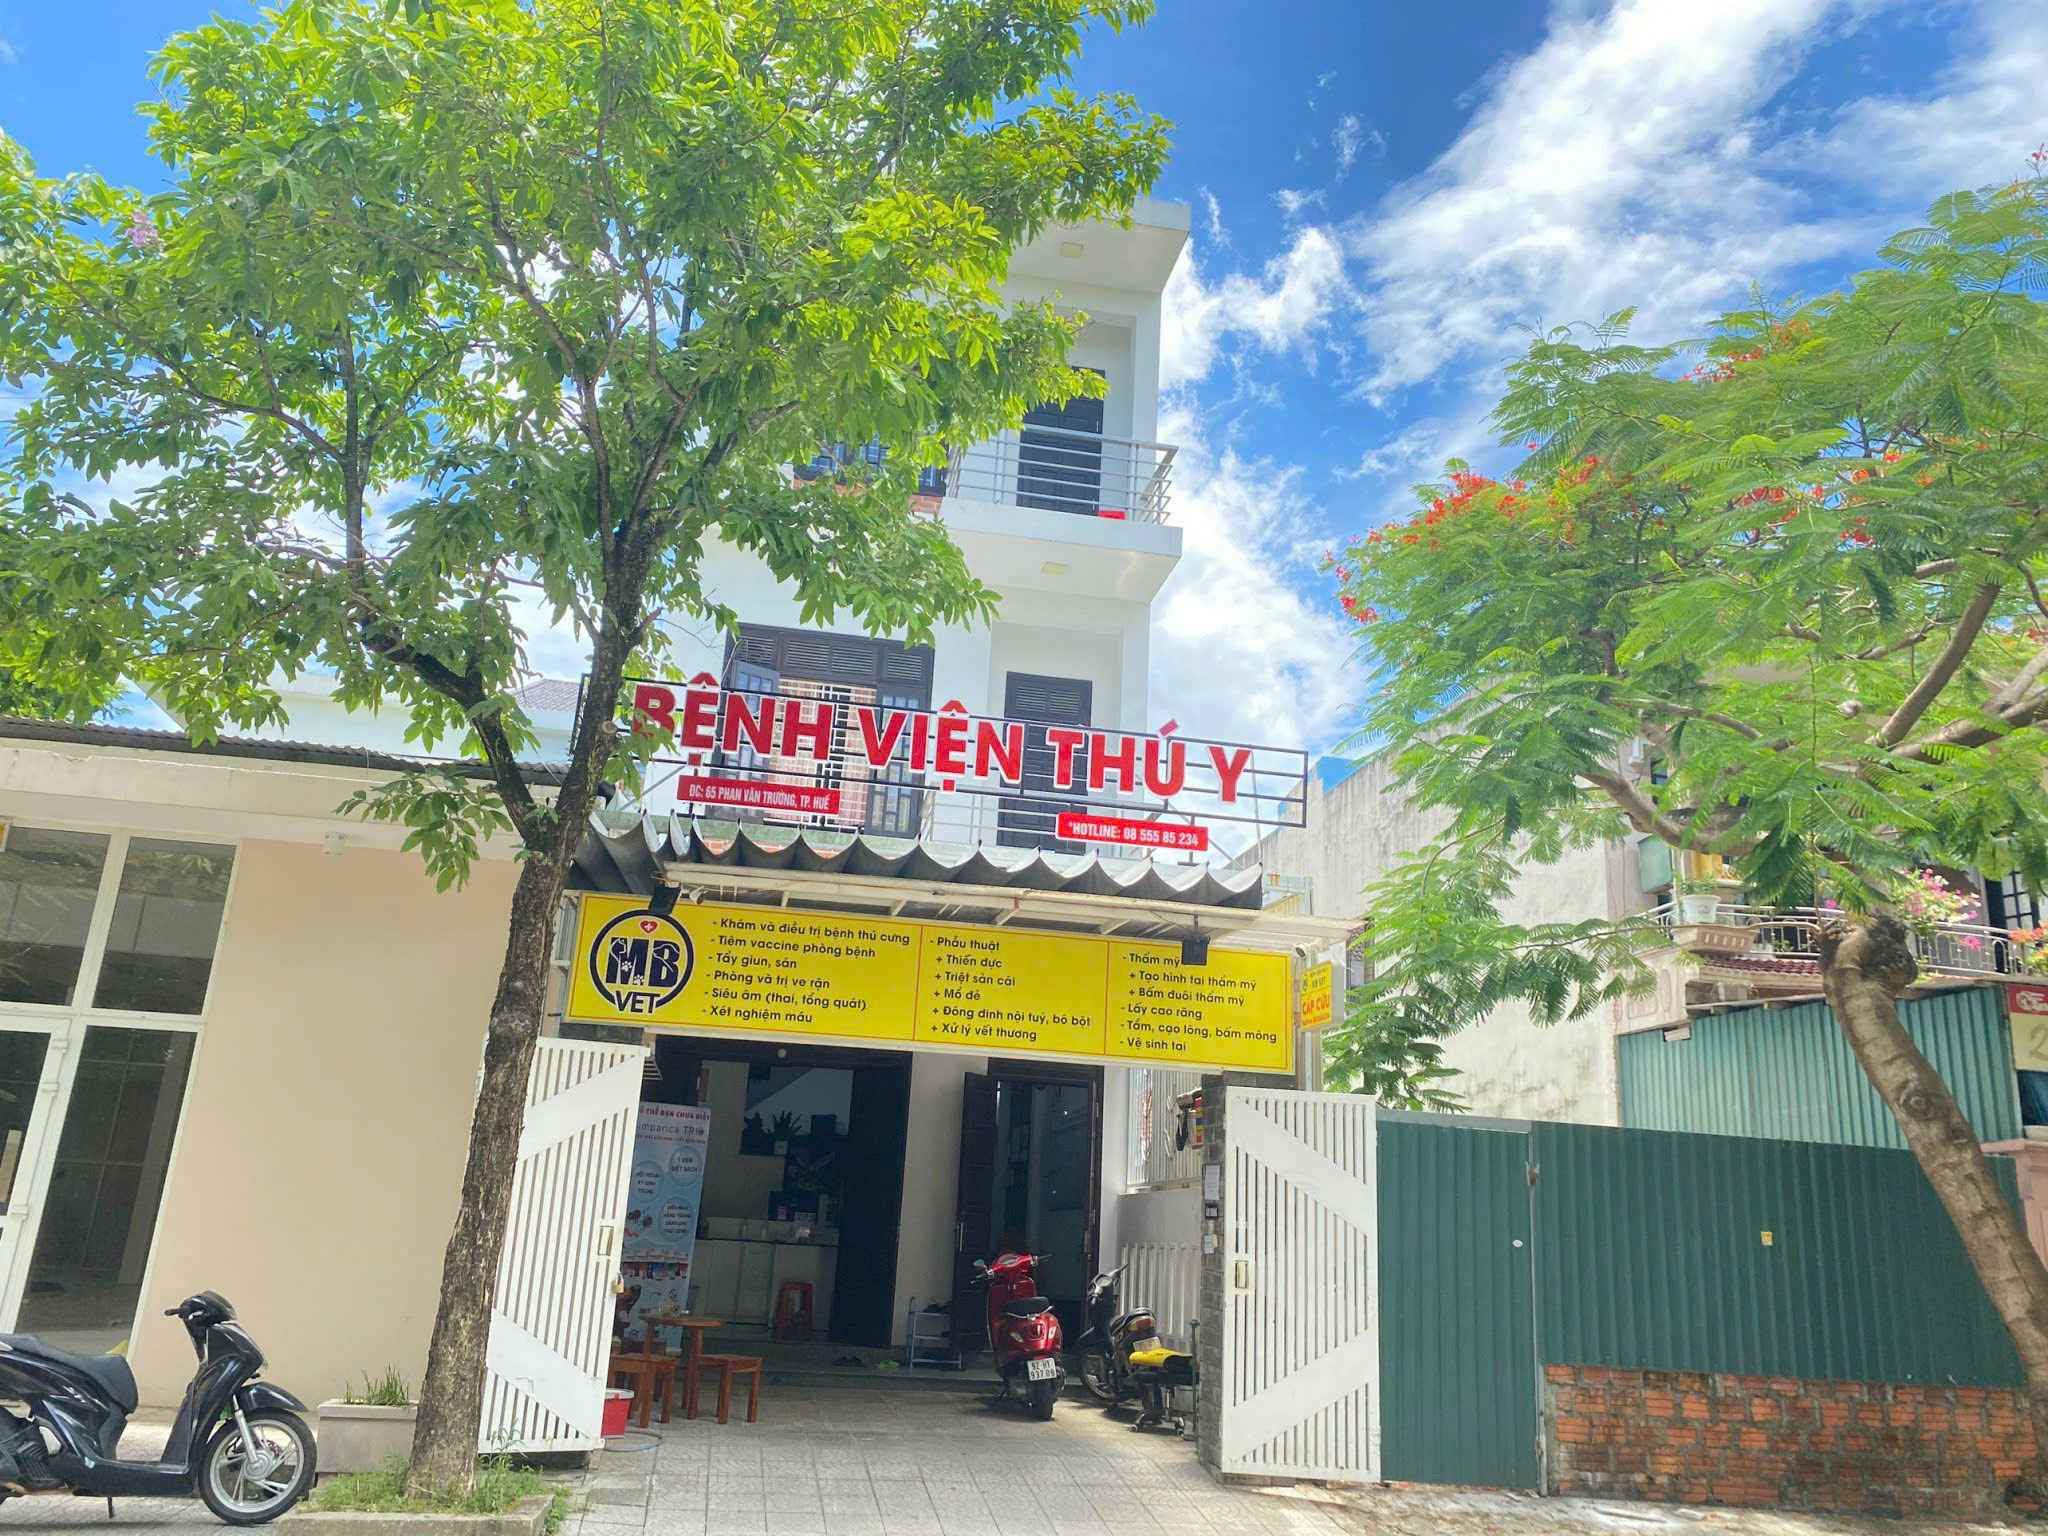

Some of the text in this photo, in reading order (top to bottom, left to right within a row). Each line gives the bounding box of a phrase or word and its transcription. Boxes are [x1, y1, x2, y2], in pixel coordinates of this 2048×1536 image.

[633, 672, 1252, 803] BỆNH VIỆN THÚ Y
[705, 786, 716, 799] 65
[718, 786, 741, 800] PHAN
[744, 787, 760, 802] VĂN
[800, 795, 811, 807] TP.
[813, 794, 830, 810] HUẾ
[1124, 827, 1137, 839] 08
[1140, 830, 1159, 842] 555
[1162, 832, 1175, 844] 85
[1179, 833, 1198, 846] 234
[720, 918, 910, 946] Khám và điều trị bệnh thú cưng
[718, 935, 876, 959] Tiêm vaccine phòng bệnh
[937, 936, 999, 953] Phẫu thuật
[606, 937, 680, 988] MB
[716, 951, 797, 969] Tẩy giun, sán
[946, 954, 976, 966] Thiến
[1129, 951, 1181, 968] Thẩm mỹ
[714, 970, 830, 991] Phòng và trị ve rận
[945, 971, 969, 984] Triệt
[997, 975, 1015, 986] cái
[1138, 970, 1256, 991] Tạo hình tai thẩm mỹ
[615, 990, 660, 1014] VET
[712, 987, 866, 1012] Siêu âm (thai, tổng quát)
[944, 986, 981, 1000] Mổ đẻ
[1139, 986, 1245, 1007] Bấm đuôi thẩm mỹ
[710, 1005, 812, 1023] Xét nghiệm máu
[943, 1005, 974, 1019] Đóng
[1007, 1010, 1024, 1023] nội
[1053, 1014, 1067, 1025] bó
[1072, 1016, 1090, 1029] bột
[1128, 1001, 1202, 1021] Lấy cao răng
[942, 1022, 1037, 1042] Xử lý vết thương
[1127, 1017, 1154, 1032] Tắm,
[1184, 1024, 1212, 1039] lông,
[1216, 1025, 1241, 1038] bấm
[1245, 1029, 1277, 1044] móng
[1127, 1037, 1186, 1051] Vệ sinh tai
